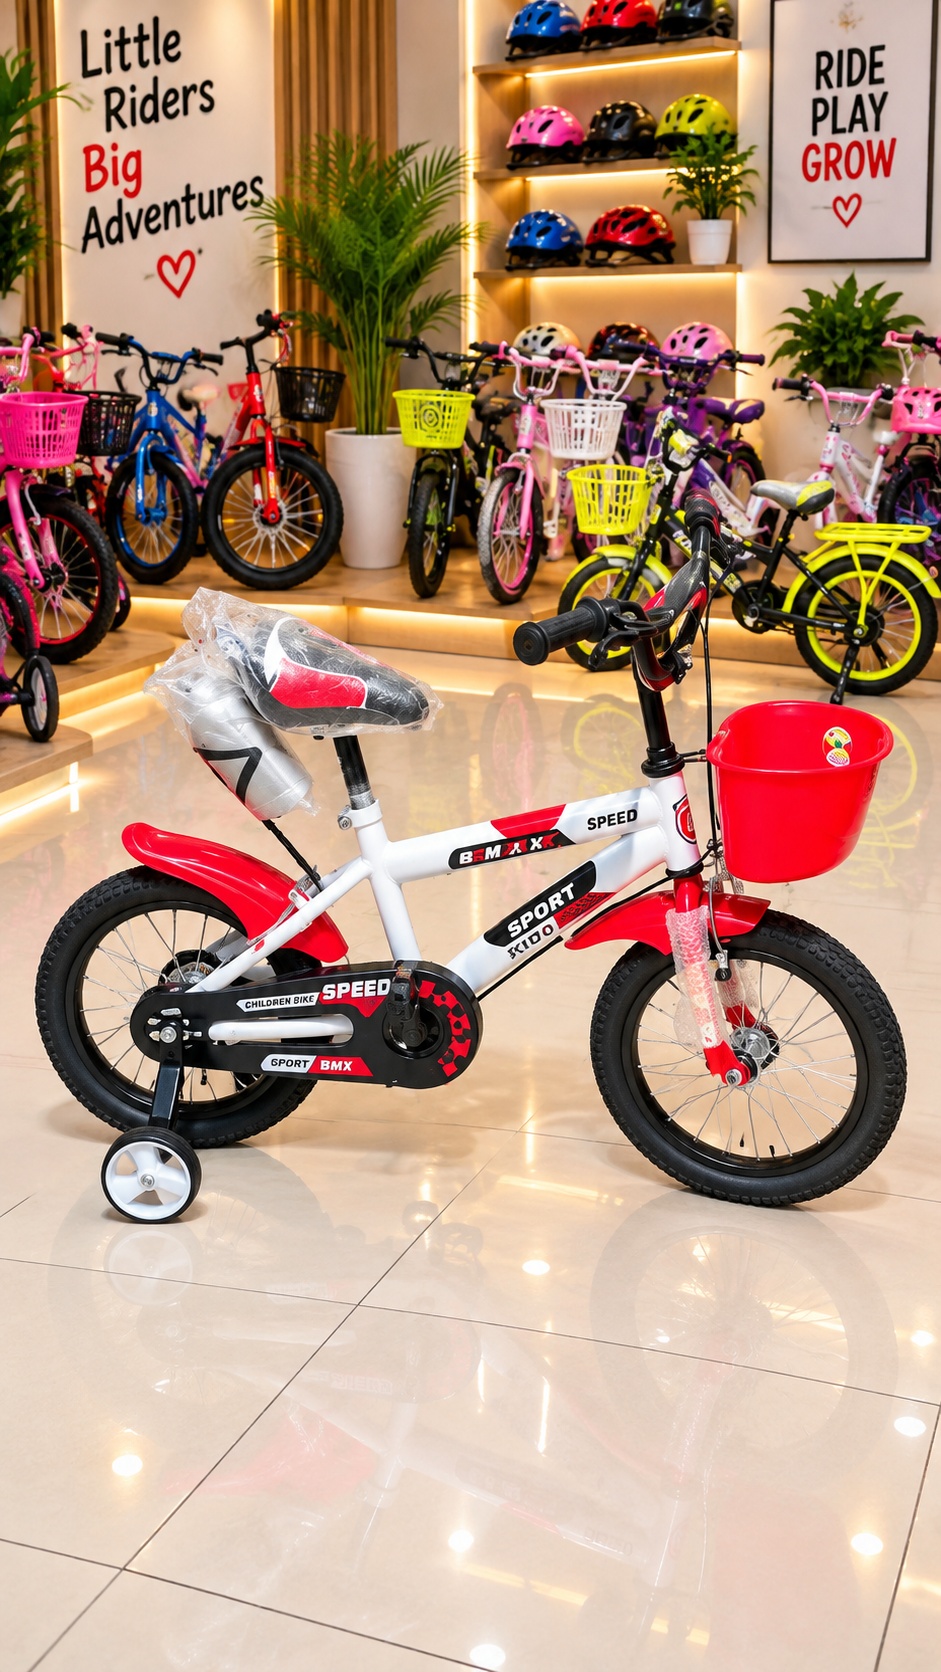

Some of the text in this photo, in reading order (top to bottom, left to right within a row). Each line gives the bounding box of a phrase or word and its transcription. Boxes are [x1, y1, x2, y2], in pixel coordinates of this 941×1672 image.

[80, 15, 182, 79] Little
[815, 44, 886, 91] RIDE
[103, 75, 215, 133] Riders
[811, 91, 889, 137] PLAY
[82, 142, 143, 199] Big
[801, 137, 897, 183] GROW
[81, 175, 265, 255] Adventures
[587, 808, 638, 831] SPEED
[507, 882, 575, 938] SPORT
[245, 994, 316, 1010] CHILDREN BIKE
[322, 978, 392, 1000] SPEED
[320, 1060, 353, 1071] BMX
